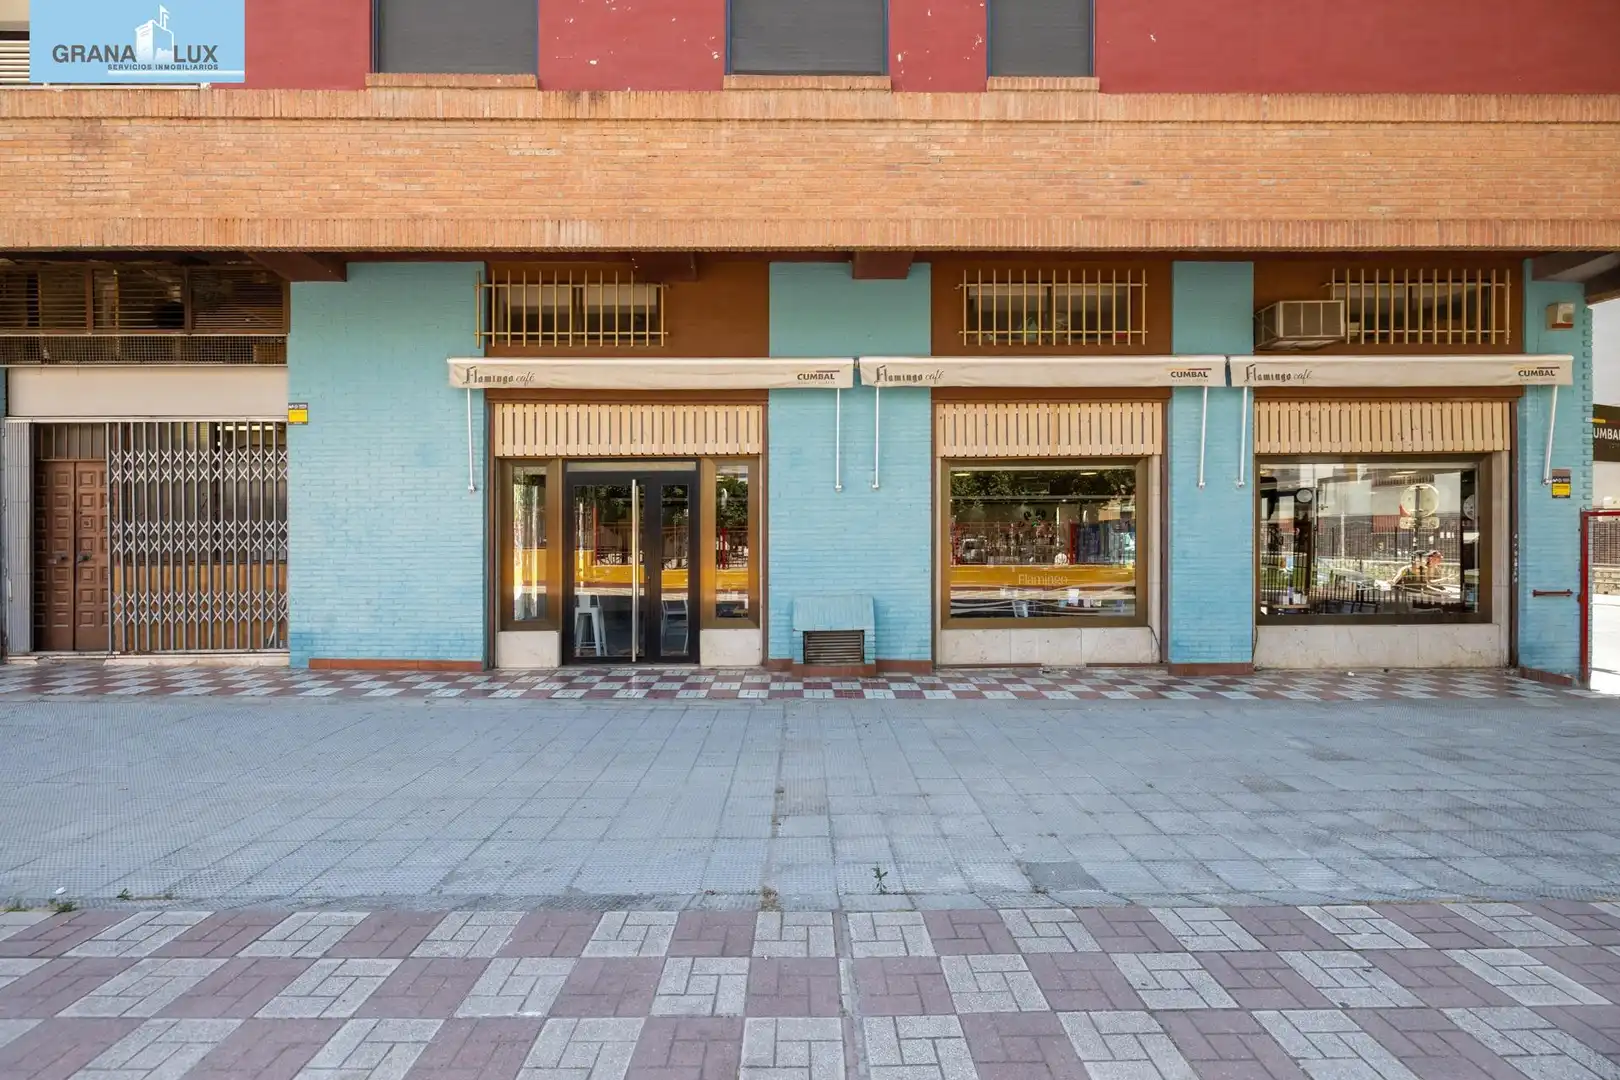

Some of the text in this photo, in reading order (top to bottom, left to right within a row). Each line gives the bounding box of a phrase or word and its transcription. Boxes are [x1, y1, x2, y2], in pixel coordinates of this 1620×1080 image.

[462, 365, 514, 385] Flamingo
[797, 373, 835, 381] CUMBAL
[873, 364, 923, 384] Flamingo
[1243, 363, 1292, 383] Flamingo
[1518, 369, 1556, 377] CUMBAL
